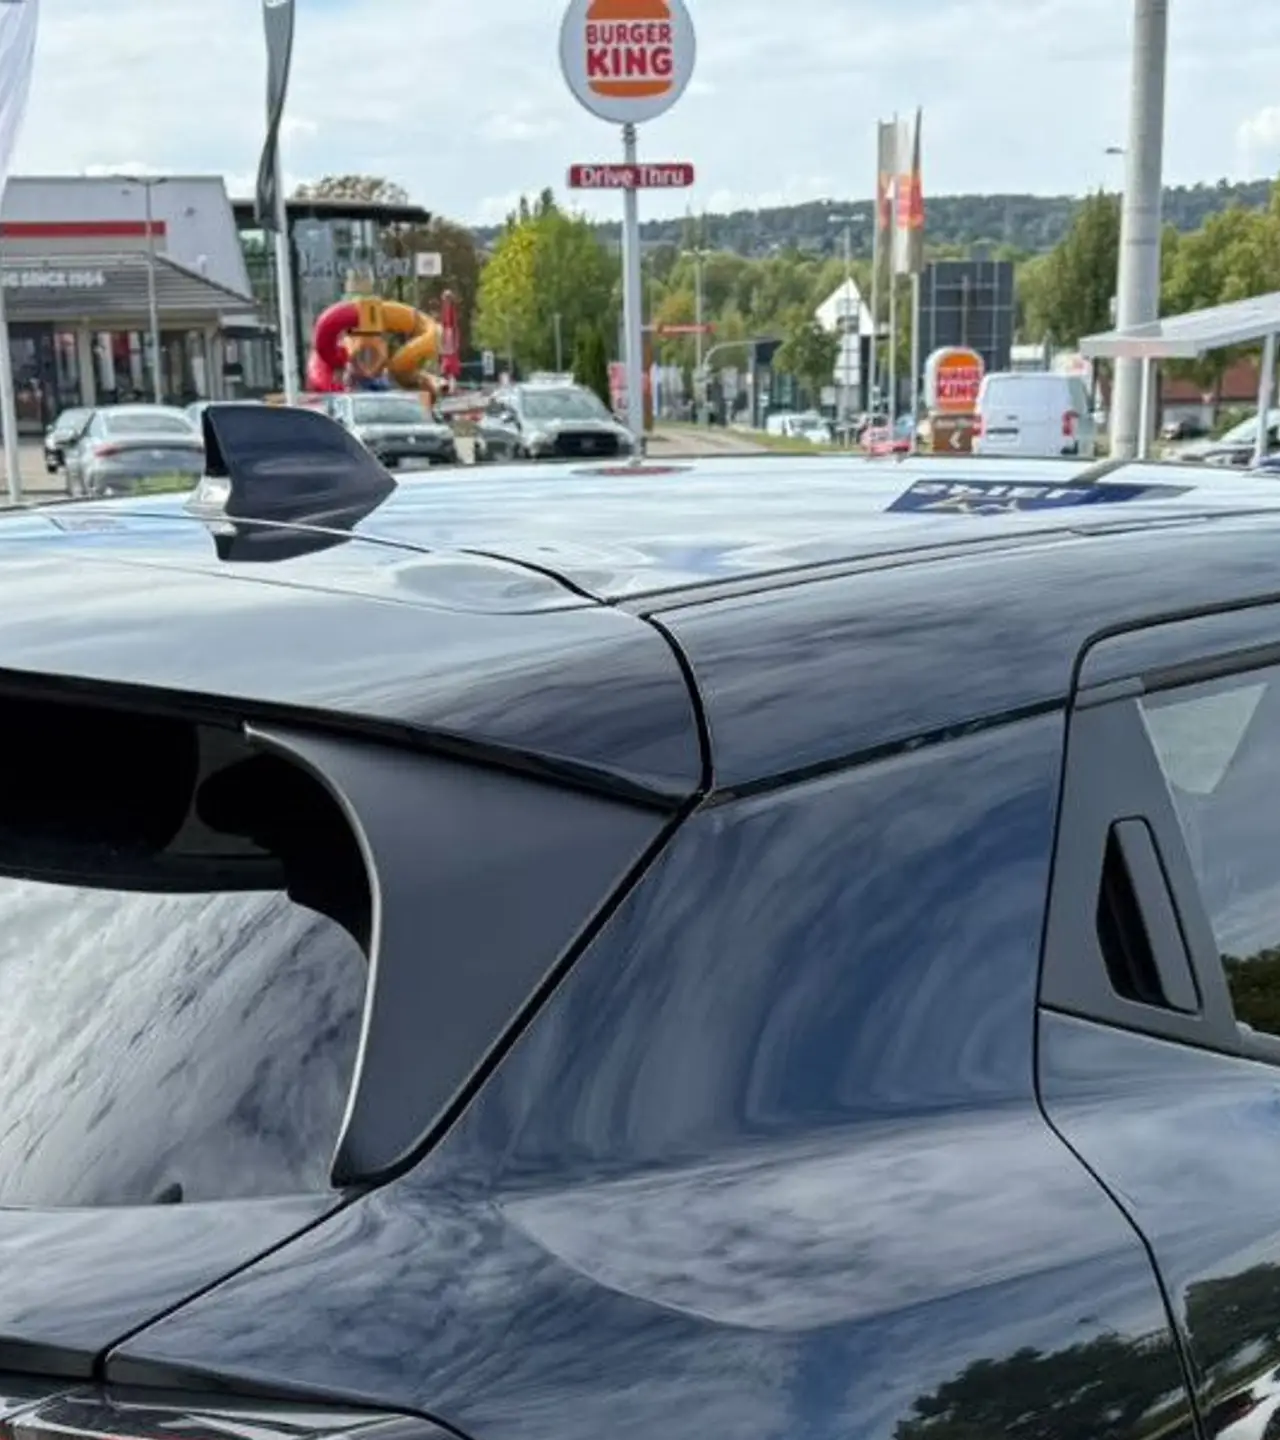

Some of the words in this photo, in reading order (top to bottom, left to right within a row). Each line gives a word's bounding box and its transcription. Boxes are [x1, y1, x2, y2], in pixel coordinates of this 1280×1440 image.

[586, 23, 673, 45] BURGER
[587, 47, 673, 77] KING
[579, 166, 634, 187] Drive
[640, 166, 685, 185] Thru
